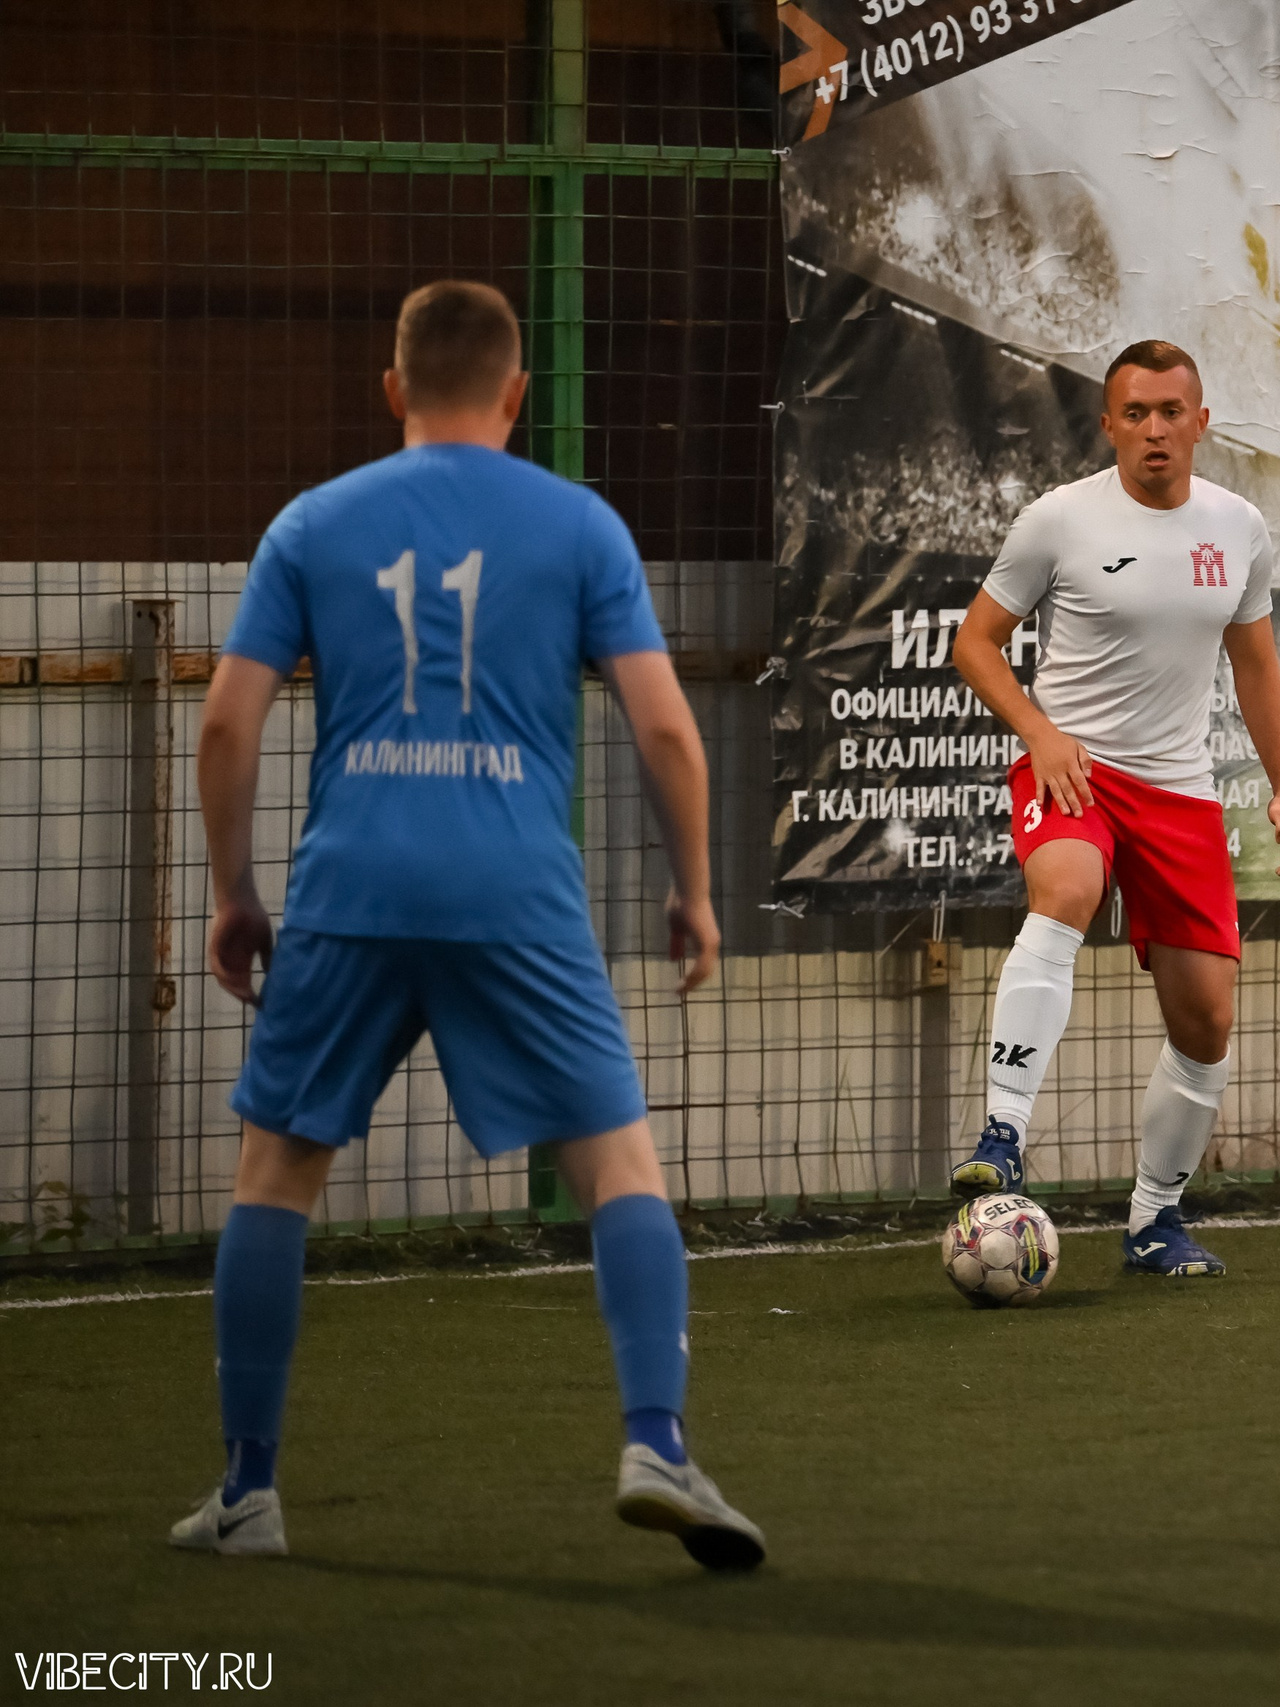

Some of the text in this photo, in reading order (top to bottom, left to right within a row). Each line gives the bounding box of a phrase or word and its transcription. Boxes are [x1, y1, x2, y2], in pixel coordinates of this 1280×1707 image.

[815, 60, 849, 104] +7
[860, 15, 965, 97] (4012)
[969, 0, 1012, 43] 93
[376, 549, 483, 715] 11
[830, 686, 995, 725] ОФИЦИАЛ
[345, 739, 524, 783] КАЛИНИНГРАД
[839, 738, 859, 770] В
[818, 785, 1014, 821] КАЛИНИНГРА
